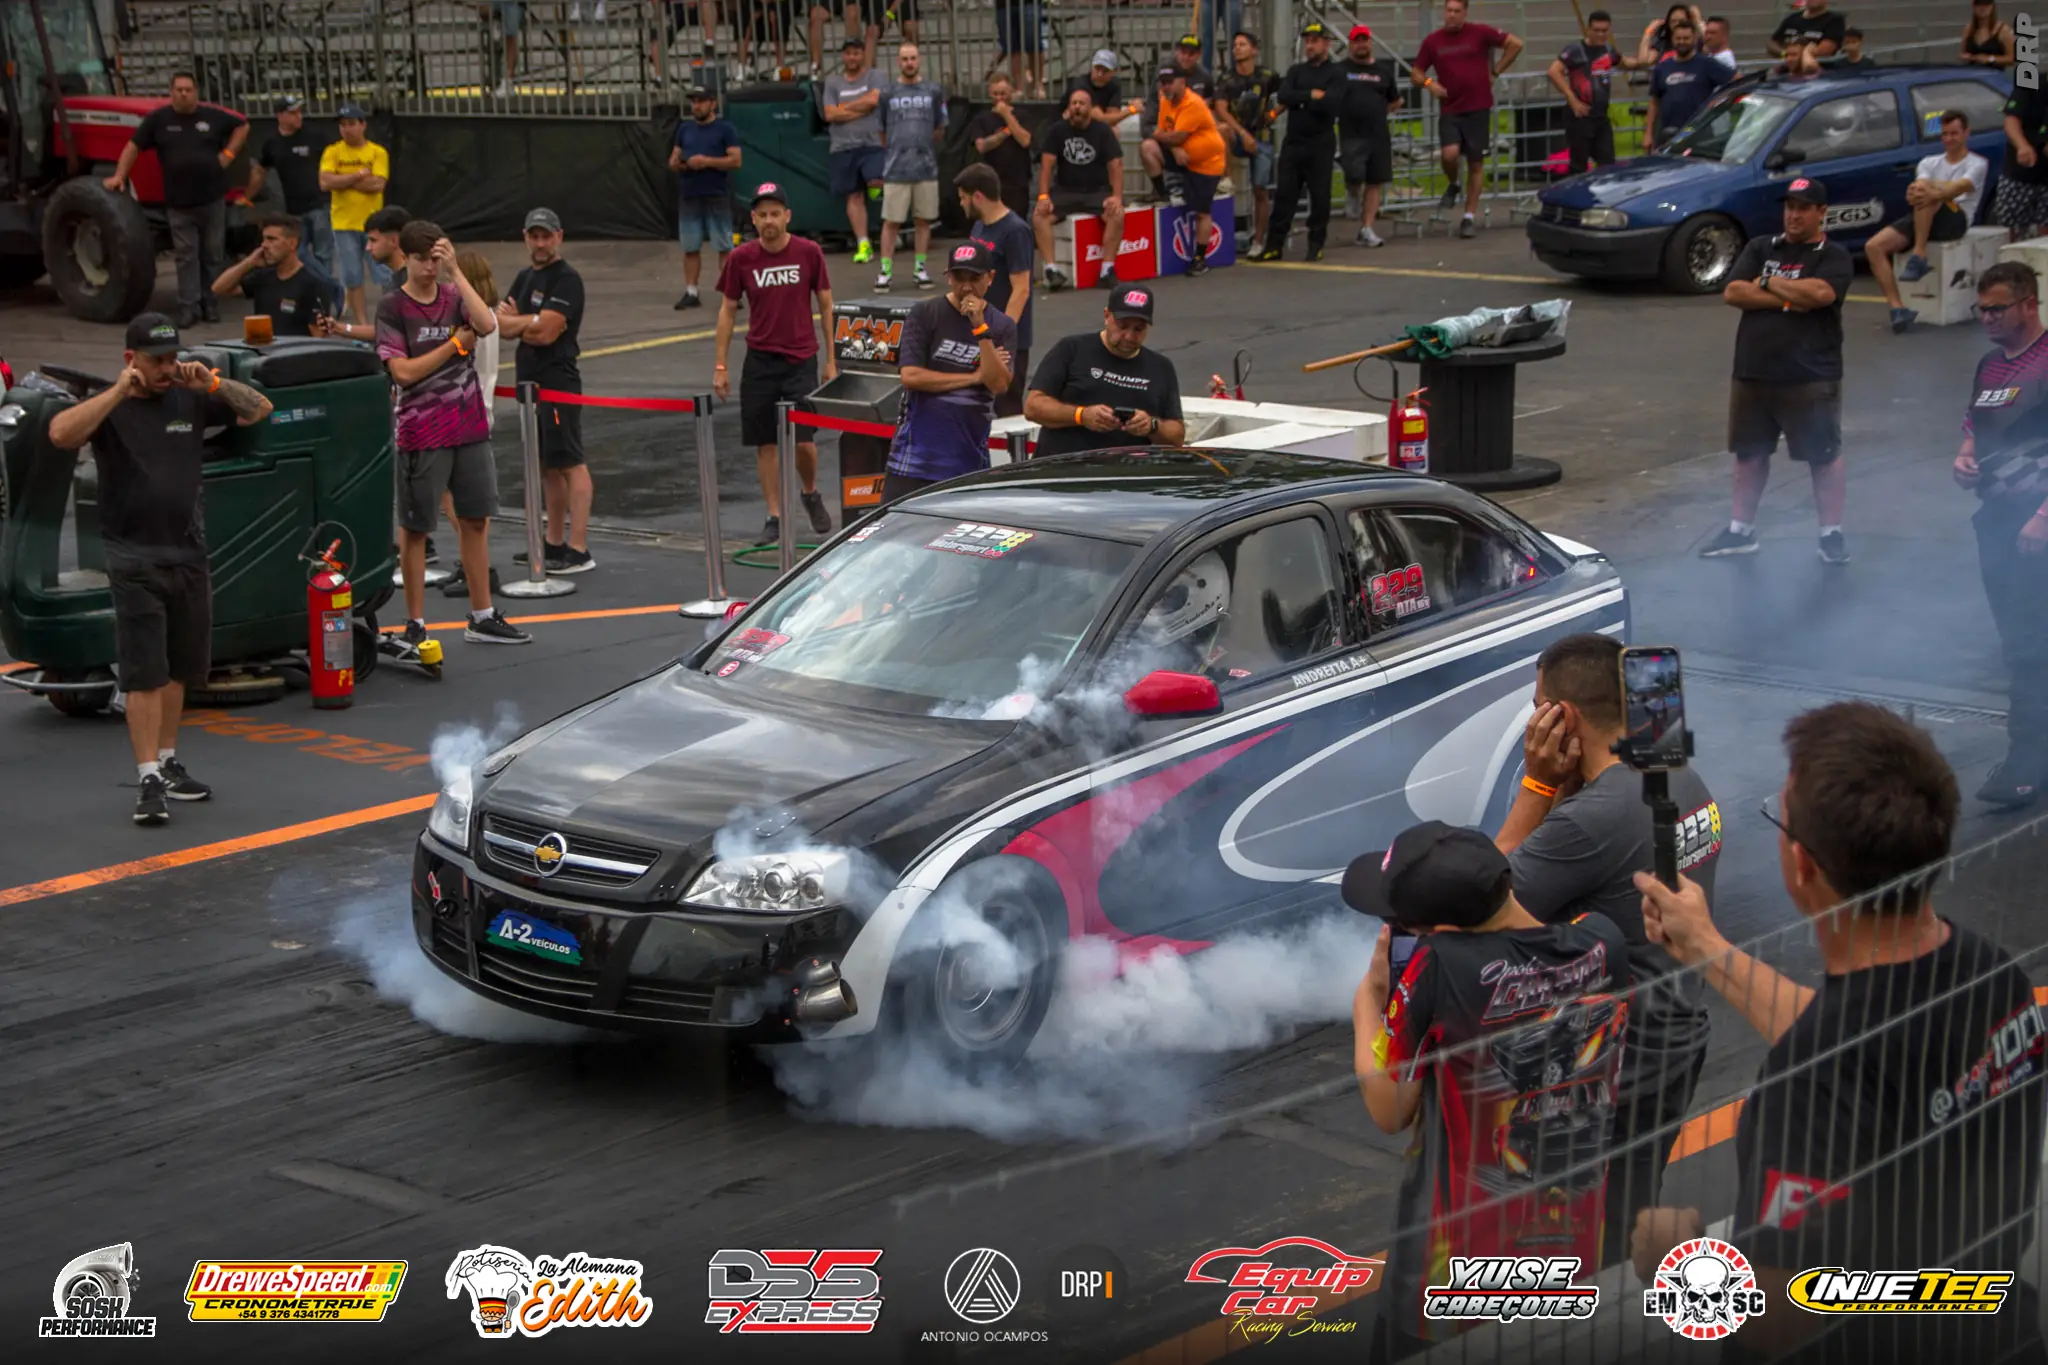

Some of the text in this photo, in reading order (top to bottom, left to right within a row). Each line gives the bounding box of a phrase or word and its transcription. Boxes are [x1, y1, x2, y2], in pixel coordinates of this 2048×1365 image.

[752, 264, 800, 288] VANS
[938, 339, 980, 359] 333
[928, 539, 990, 554] Motorsport
[1371, 563, 1426, 615] 229
[1292, 659, 1350, 688] ANDRETTA
[1677, 840, 1712, 872] otorsport
[499, 918, 532, 944] A-2
